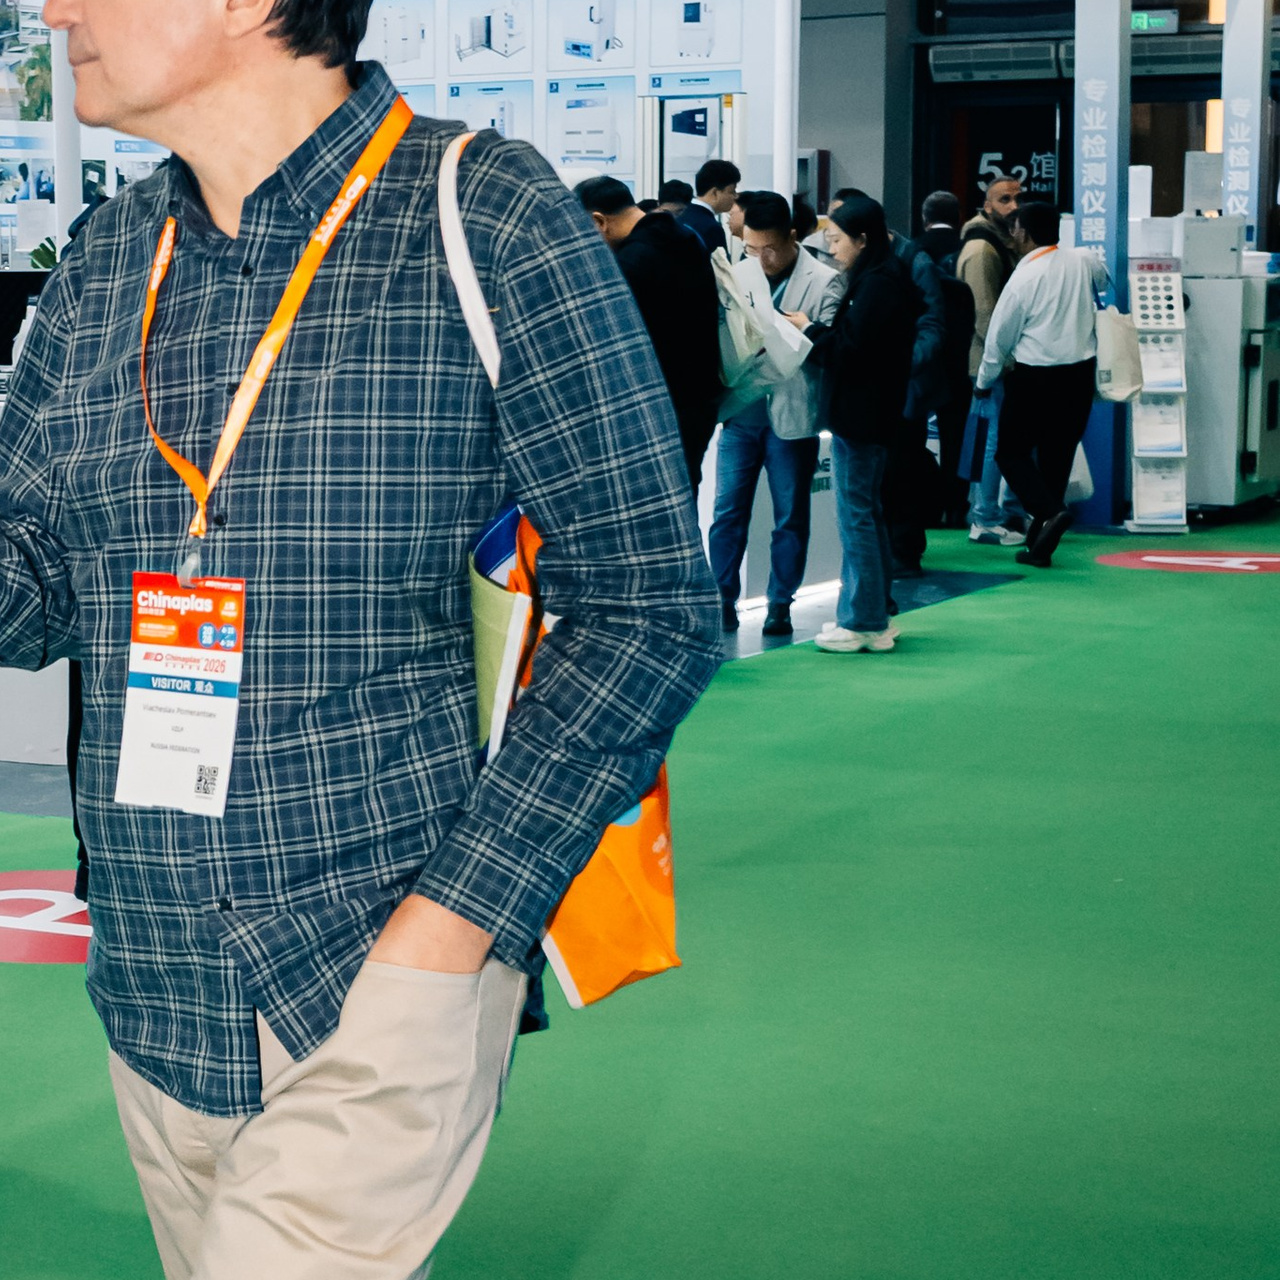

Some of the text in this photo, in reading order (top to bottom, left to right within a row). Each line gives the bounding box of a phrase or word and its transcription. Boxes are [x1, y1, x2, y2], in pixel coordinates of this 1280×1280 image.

[1030, 151, 1056, 179] 馆
[136, 590, 214, 616] Chinaplas
[203, 658, 227, 674] 2026
[151, 676, 192, 692] VISITOR
